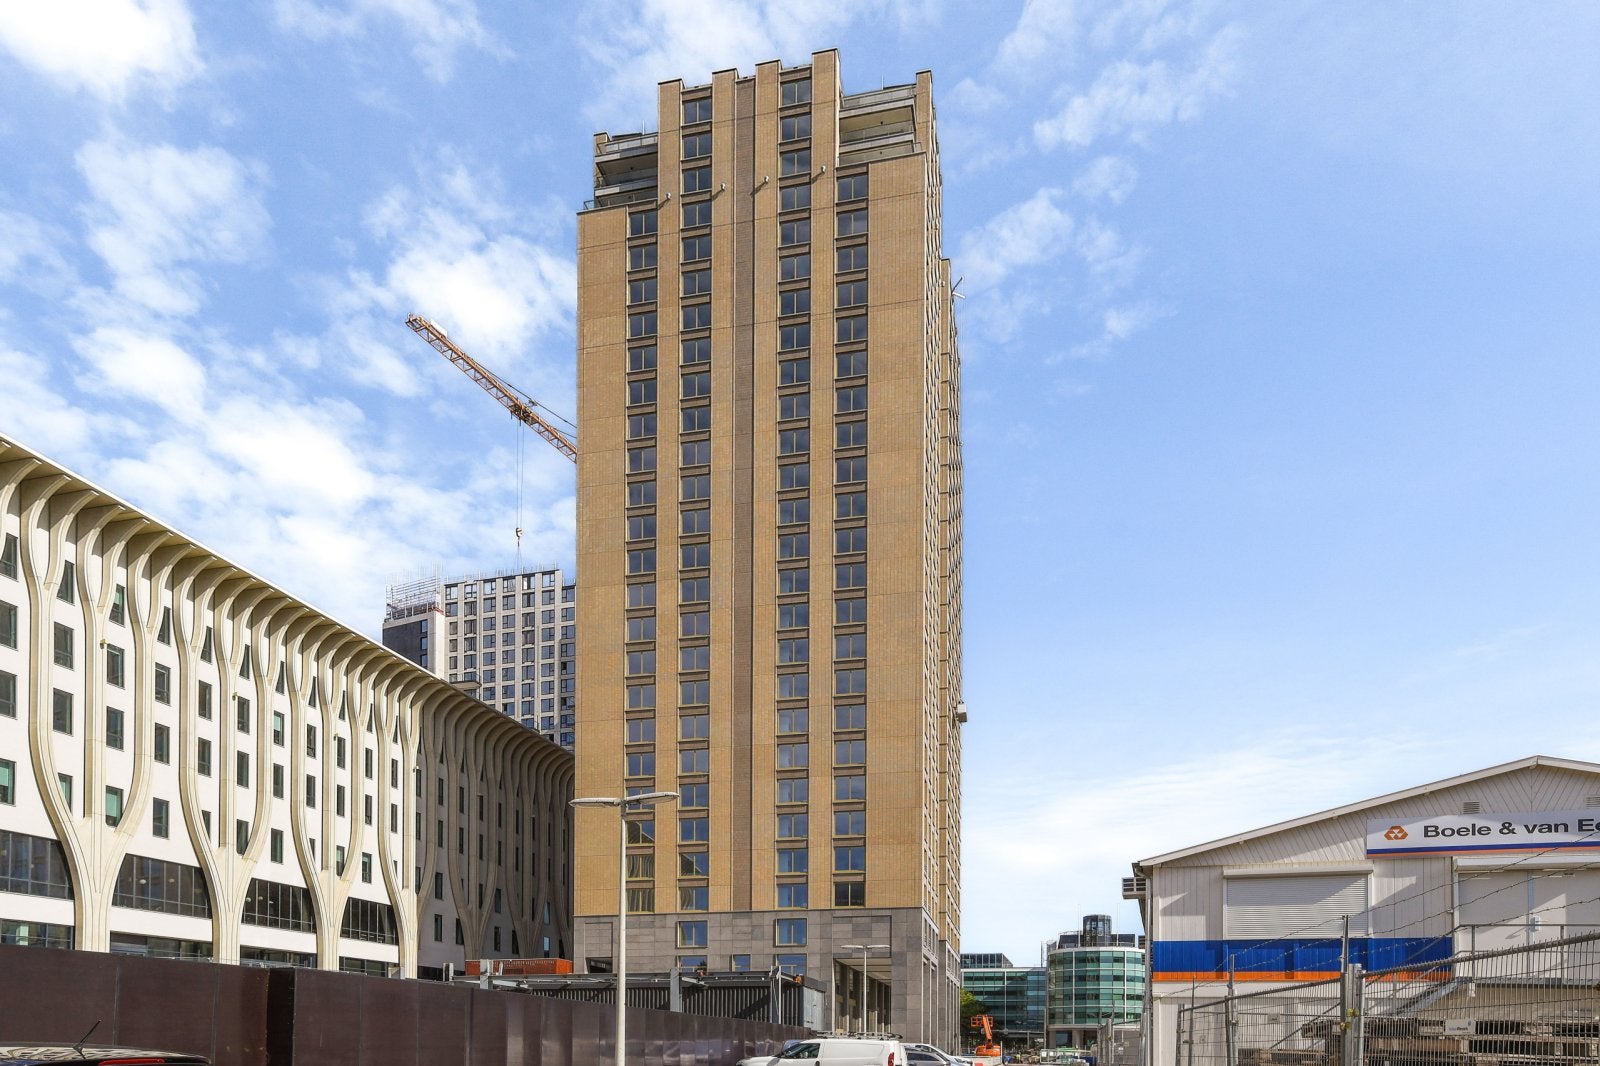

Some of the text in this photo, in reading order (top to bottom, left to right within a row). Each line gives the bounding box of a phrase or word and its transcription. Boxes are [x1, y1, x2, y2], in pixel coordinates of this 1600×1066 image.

[1424, 823, 1491, 838] Boele
[1499, 821, 1517, 835] &
[1523, 822, 1568, 834] van
